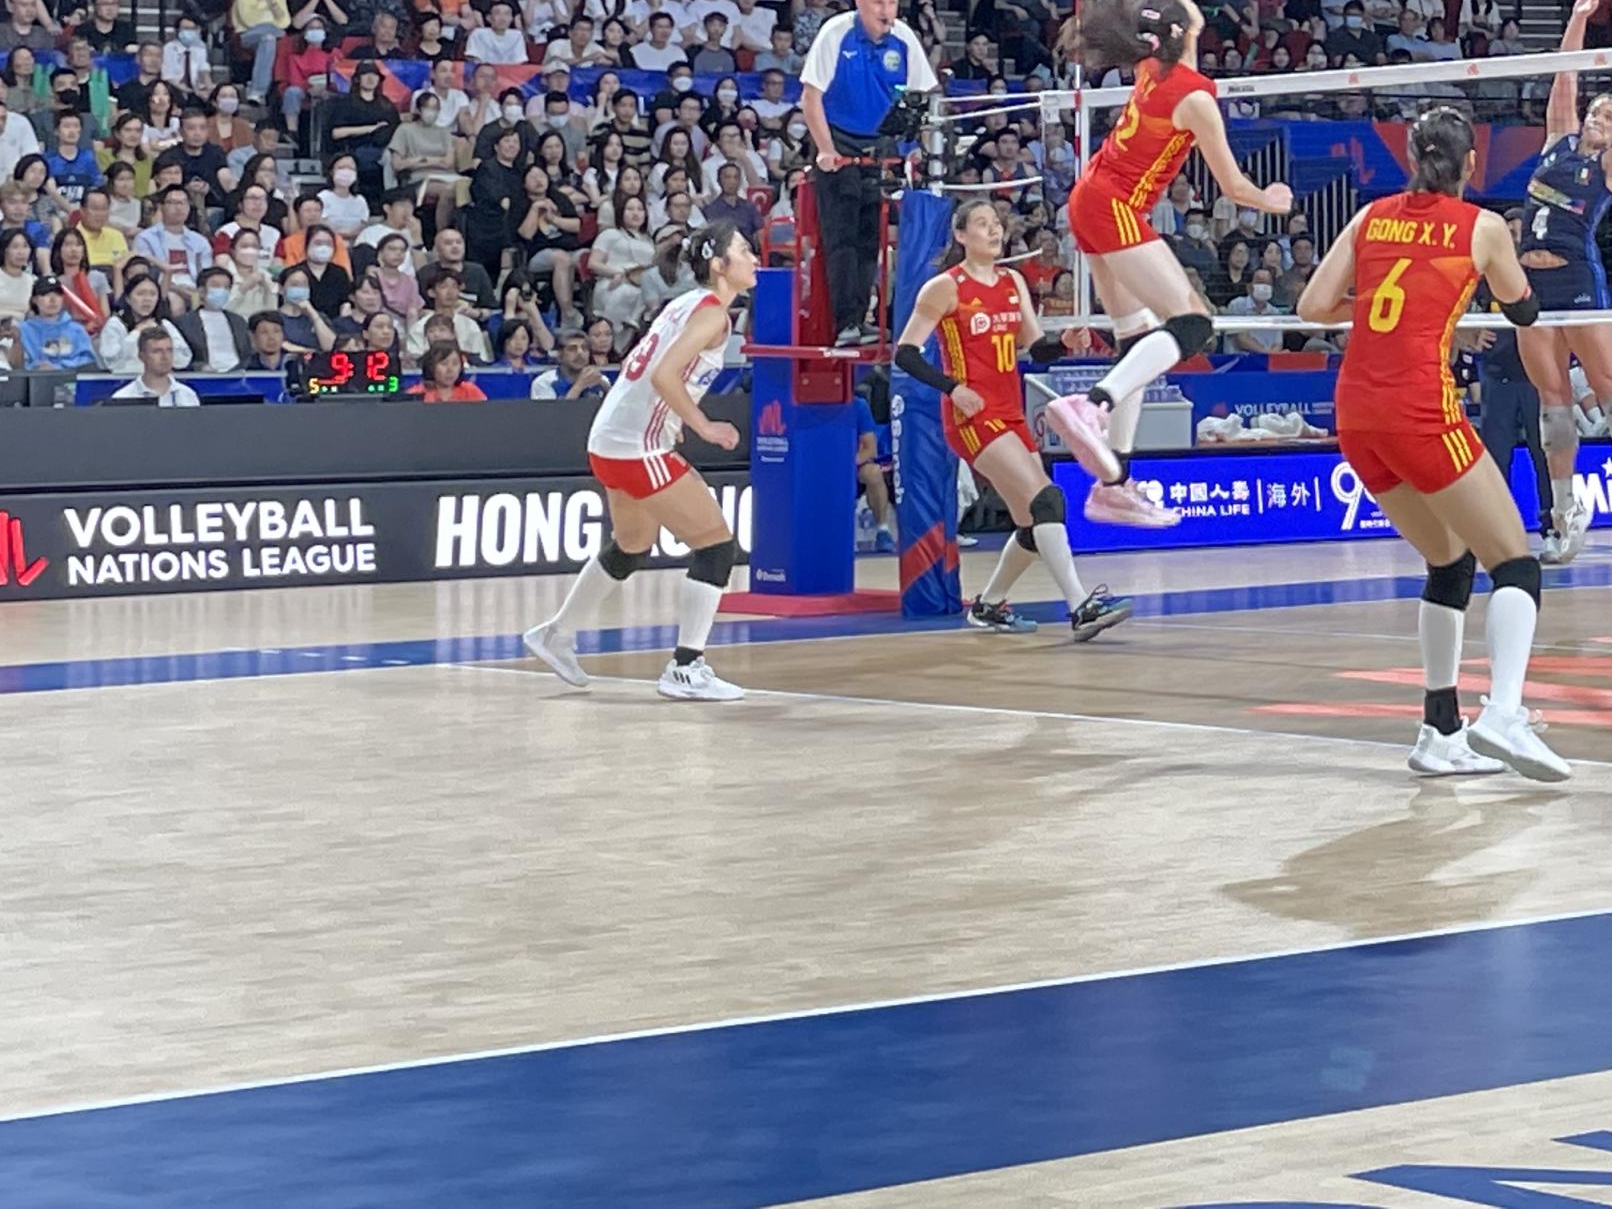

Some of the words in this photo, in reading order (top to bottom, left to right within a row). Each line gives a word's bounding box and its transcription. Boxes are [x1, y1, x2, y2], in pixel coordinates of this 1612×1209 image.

[1366, 218, 1418, 243] GONG
[1368, 257, 1413, 334] 6
[991, 333, 1015, 374] 10
[1220, 503, 1250, 516] LIFE
[1266, 481, 1311, 509] 海外
[63, 497, 376, 548] VOLLEYBALL
[435, 490, 604, 568] HONG
[67, 549, 229, 586] NATIONS
[242, 542, 377, 578] LEAGUE
